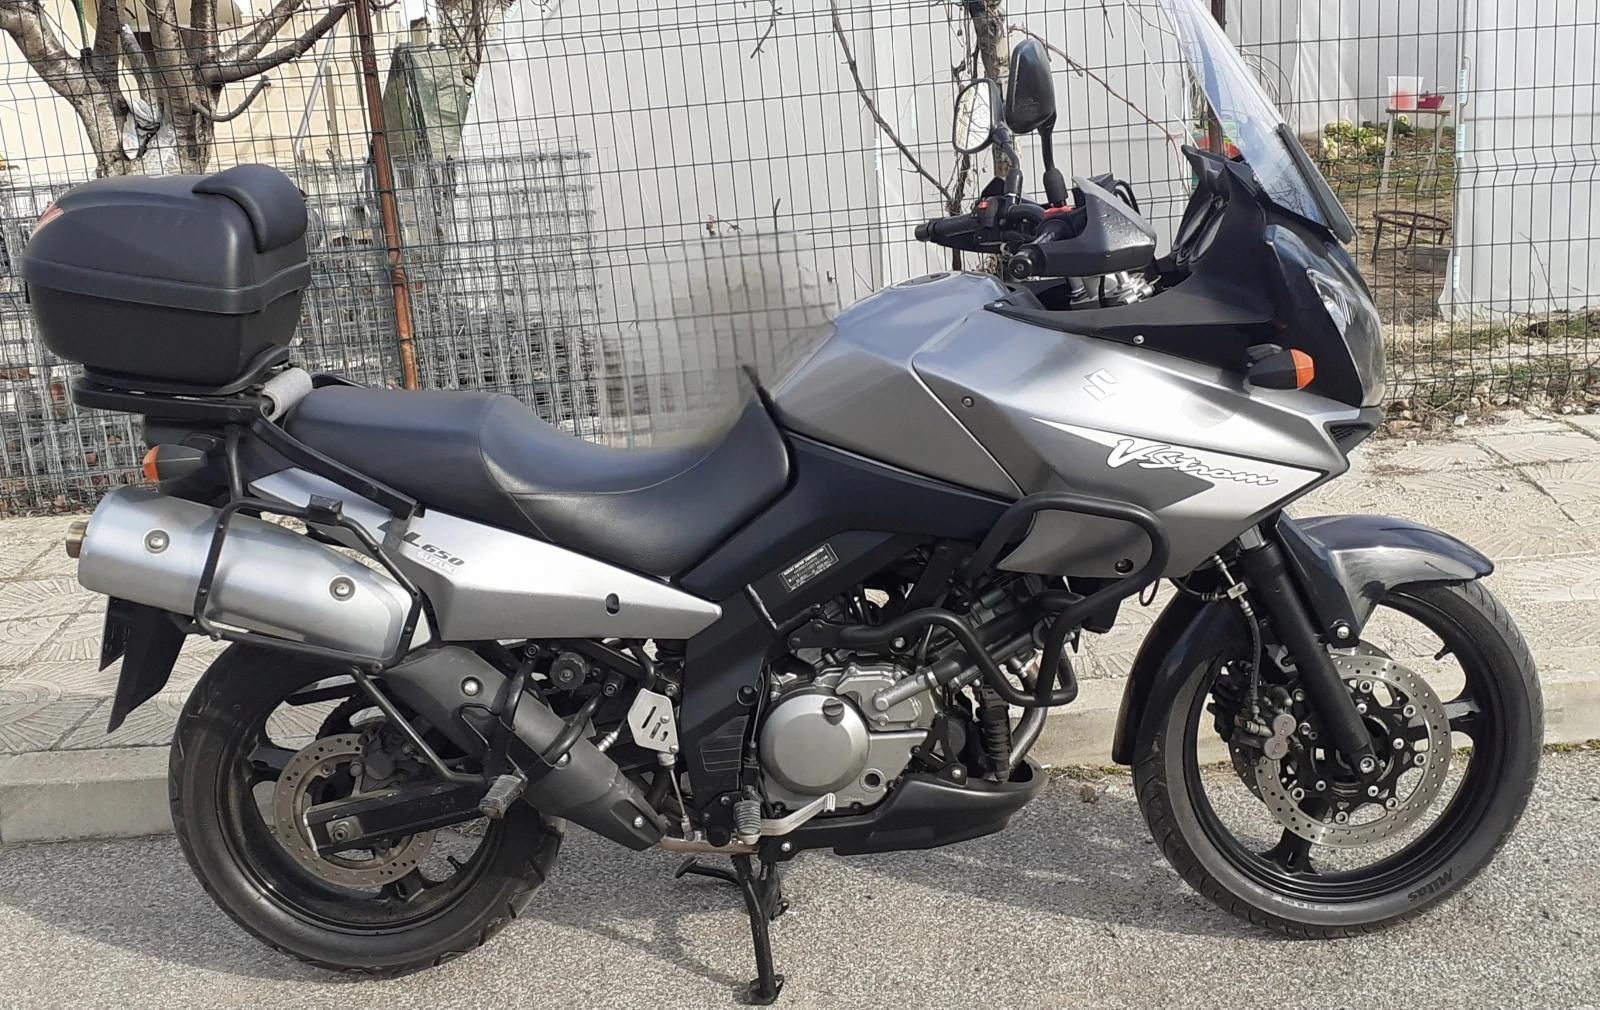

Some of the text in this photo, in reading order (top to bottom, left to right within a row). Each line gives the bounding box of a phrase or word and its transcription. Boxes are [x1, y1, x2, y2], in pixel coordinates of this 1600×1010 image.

[377, 521, 465, 566] L650
[416, 551, 458, 575] SUZUKI
[1407, 867, 1453, 902] Mitas
